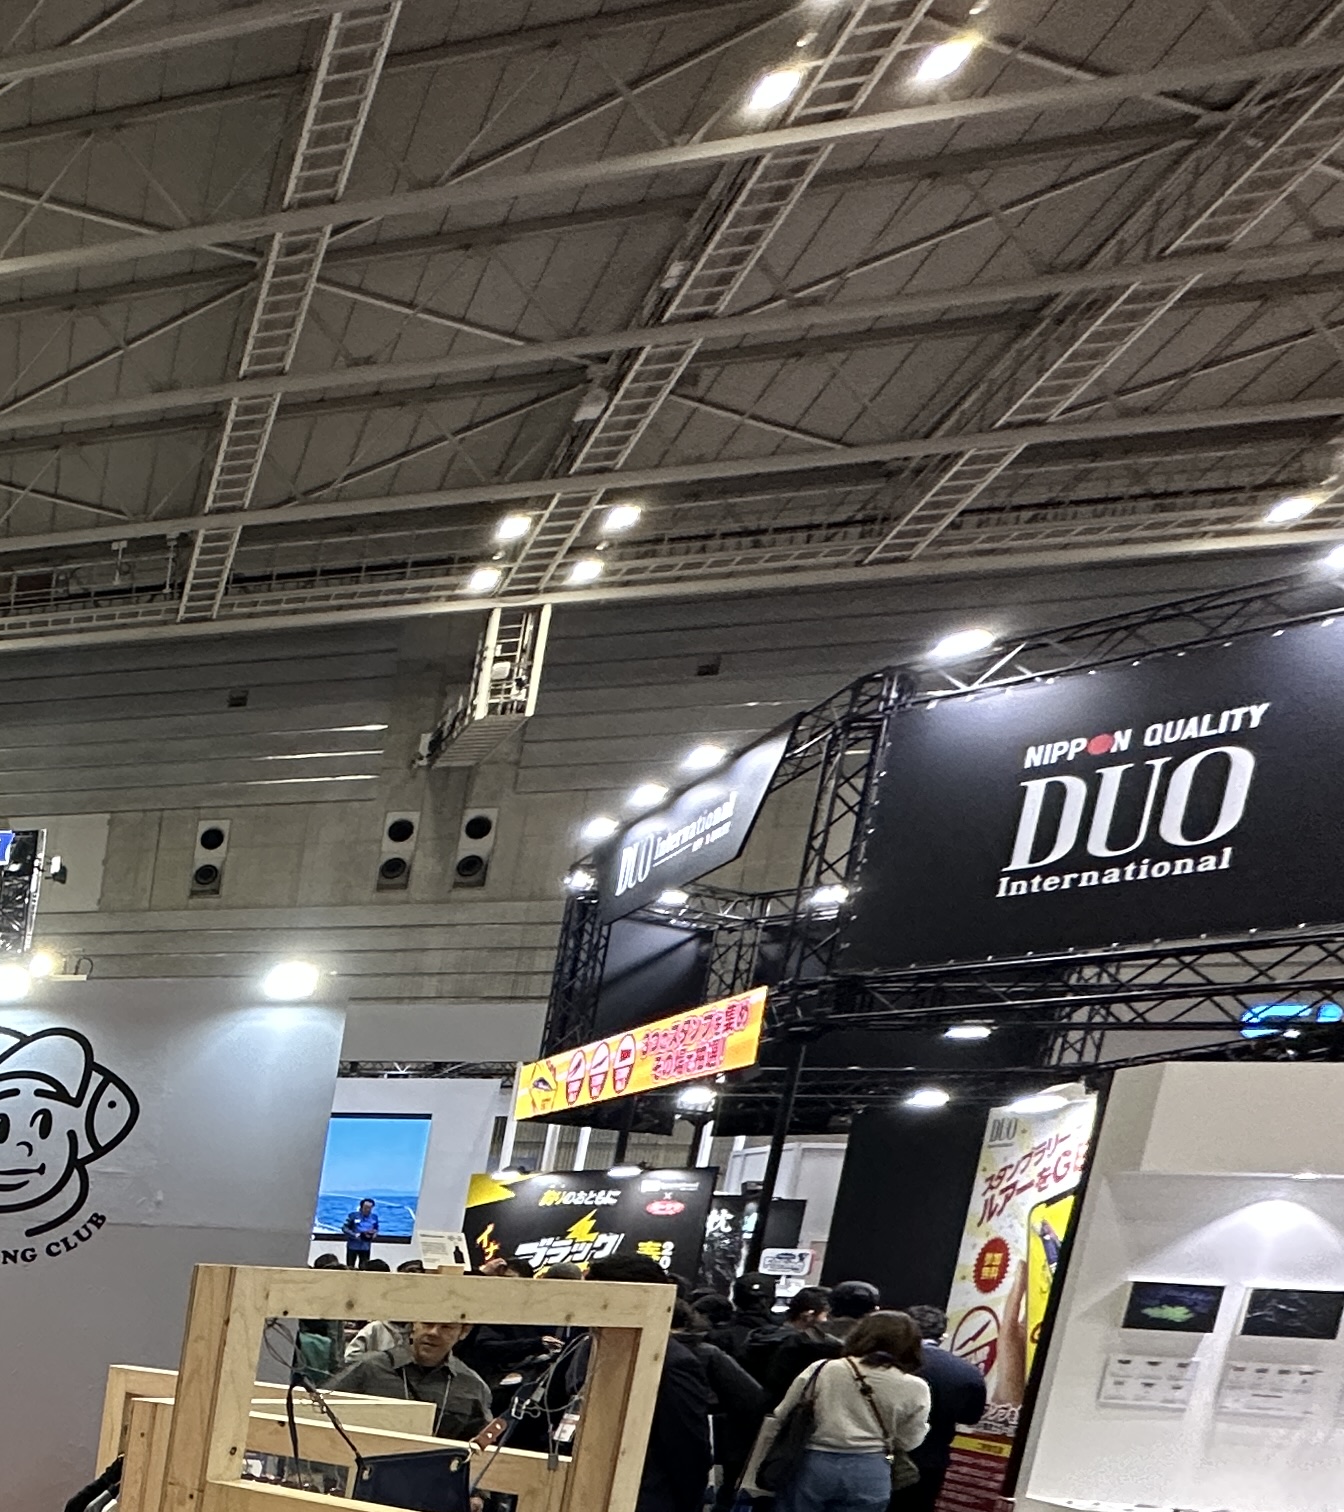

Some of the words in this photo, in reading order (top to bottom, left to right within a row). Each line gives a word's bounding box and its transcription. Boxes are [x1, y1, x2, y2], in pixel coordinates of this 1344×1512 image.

[1143, 702, 1271, 747] QUALITY
[1001, 745, 1256, 872] DUO
[995, 847, 1233, 898] International
[989, 1117, 1018, 1142] DUO
[45, 1211, 107, 1257] CLUB
